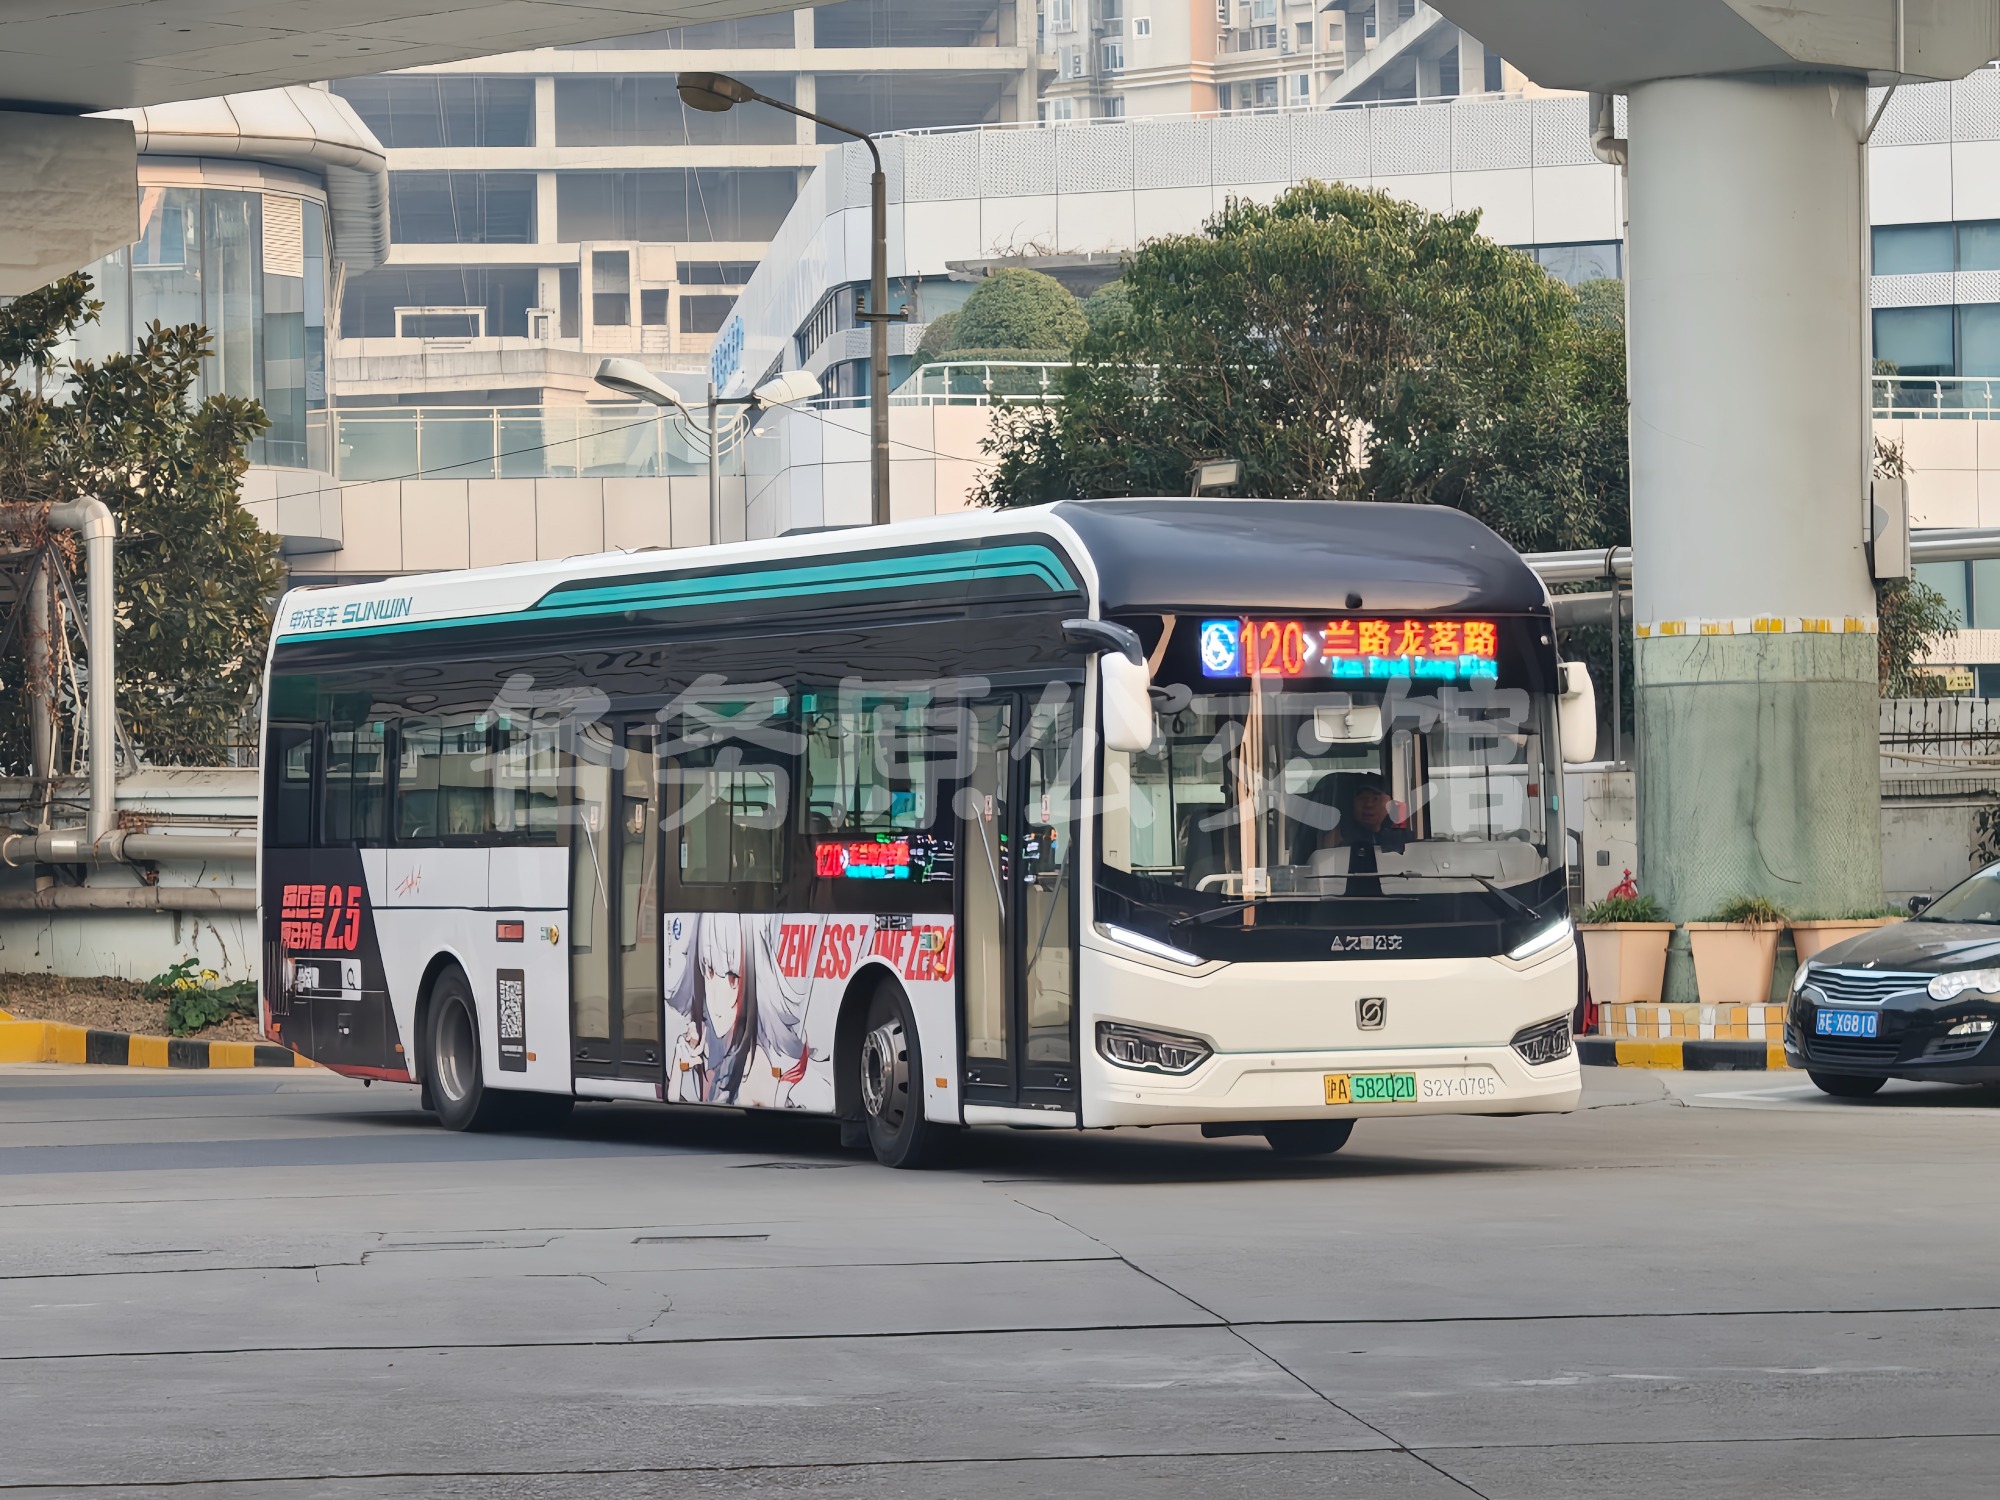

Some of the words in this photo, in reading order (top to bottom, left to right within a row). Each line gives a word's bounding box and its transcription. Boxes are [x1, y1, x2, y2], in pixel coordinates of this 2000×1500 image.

[341, 597, 413, 624] SUNWIN
[1240, 620, 1303, 674] 120
[1323, 619, 1497, 657] 兰路龙茗路
[777, 923, 856, 980] ZENESS
[1423, 1077, 1496, 1097] S2Y-0795
